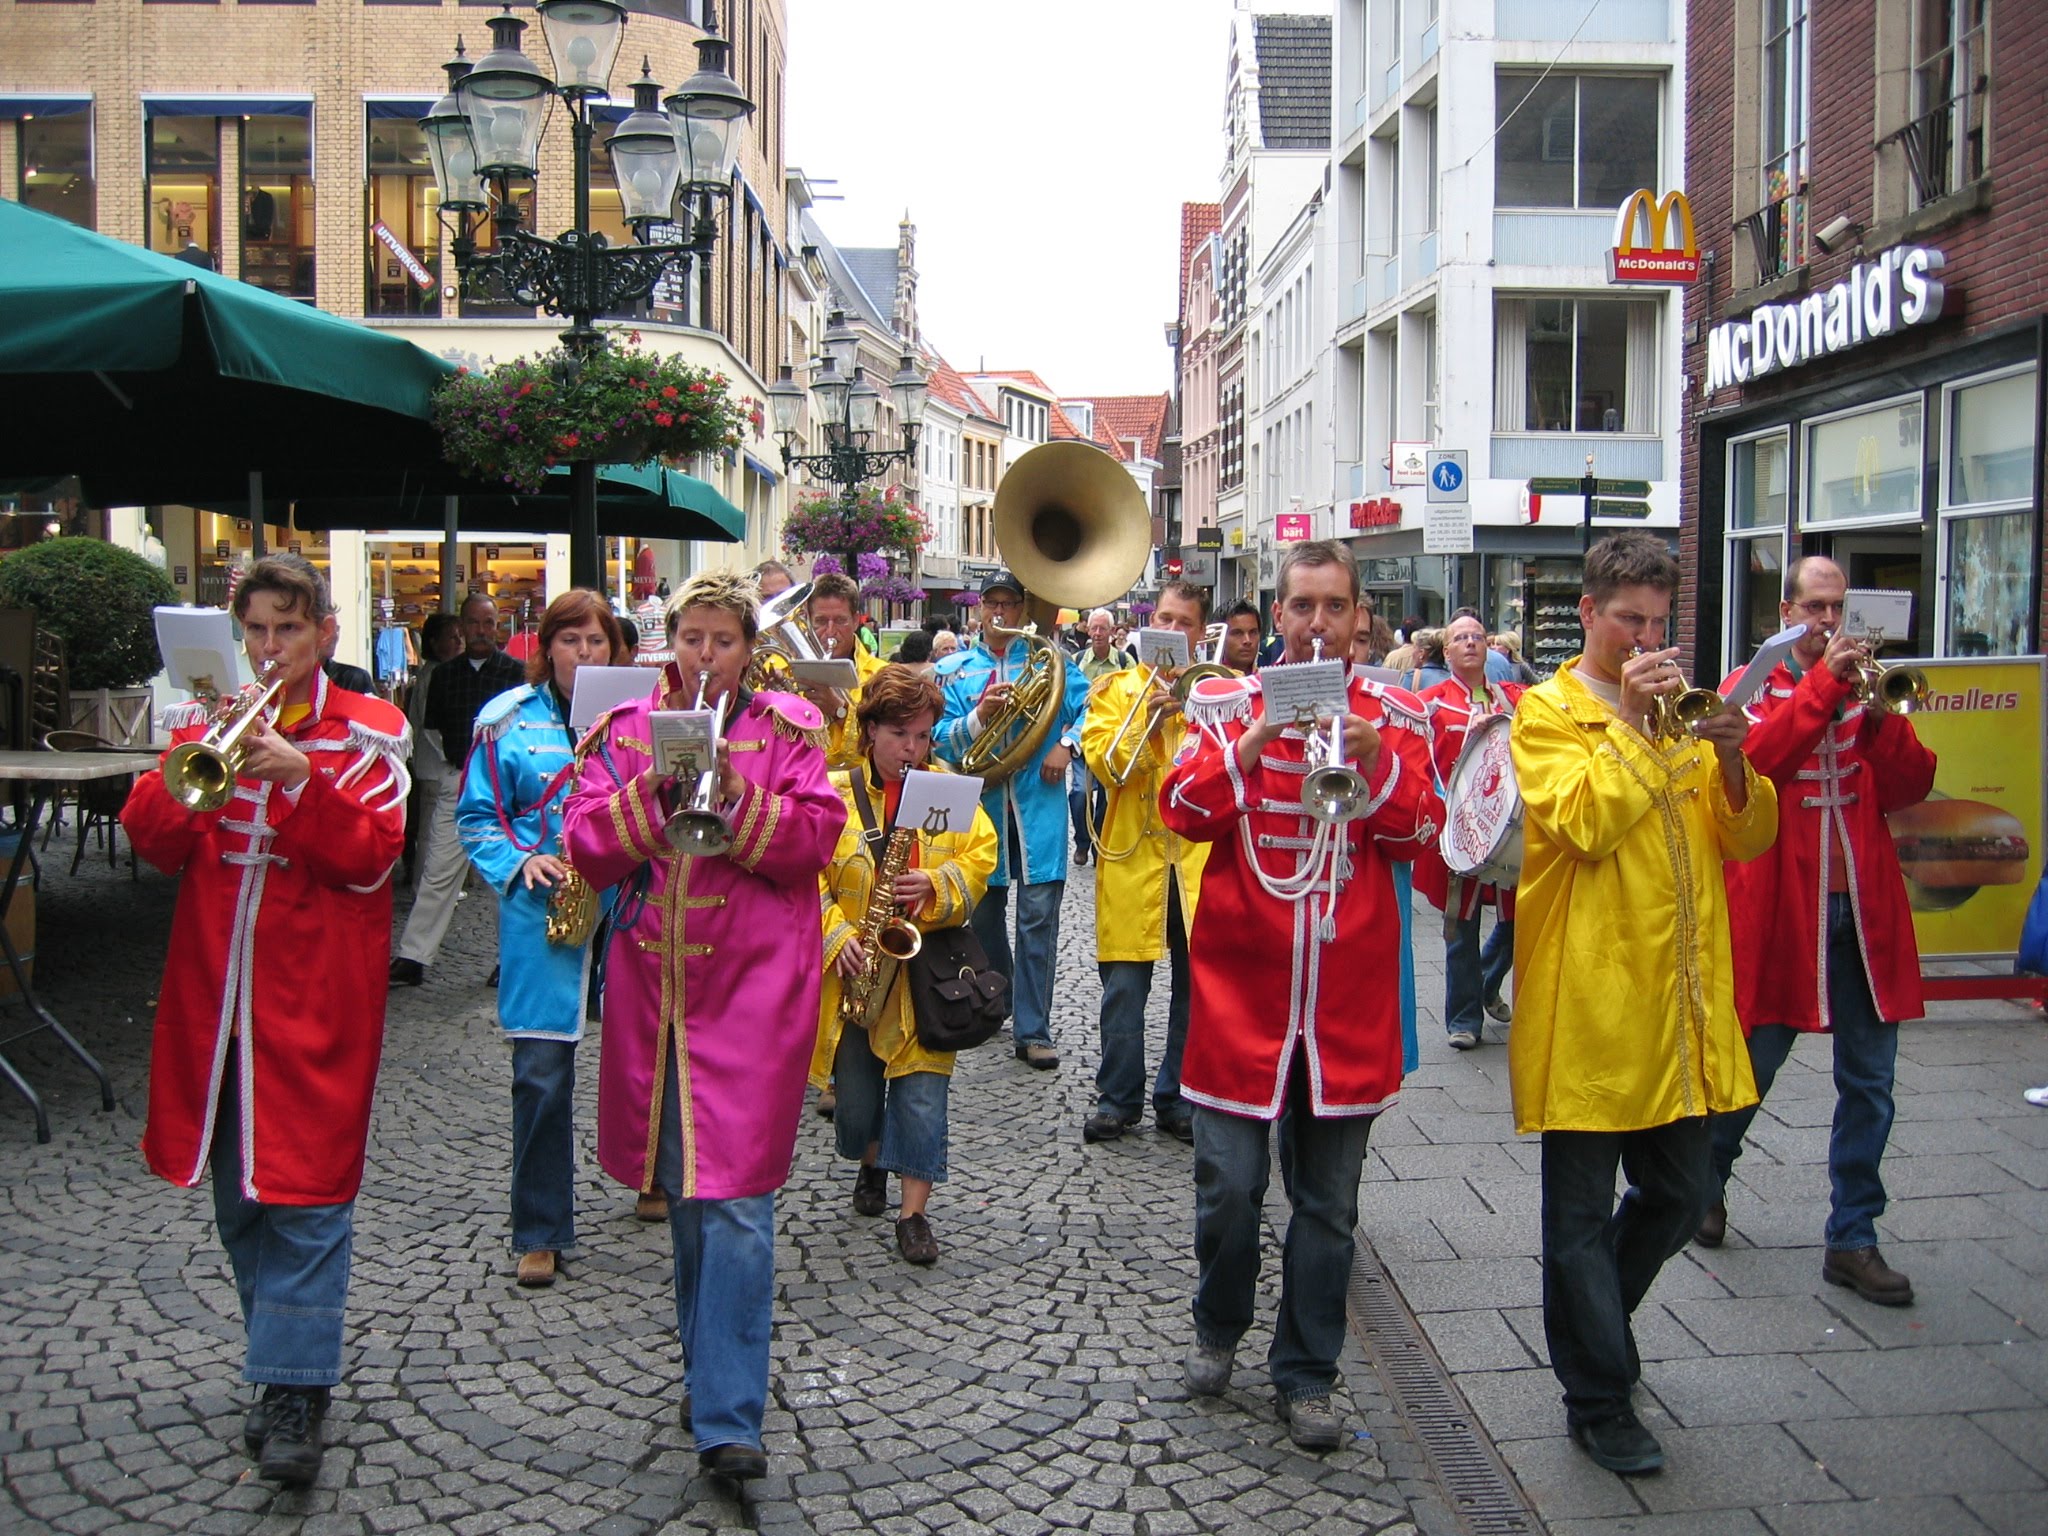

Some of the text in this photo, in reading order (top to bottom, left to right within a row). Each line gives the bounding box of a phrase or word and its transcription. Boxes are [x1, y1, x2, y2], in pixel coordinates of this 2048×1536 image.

[377, 226, 429, 283] UITVERKOOP
[1618, 258, 1696, 271] McDonald's
[1706, 245, 1936, 392] McDonald's
[1282, 527, 1304, 538] bart
[1198, 540, 1221, 548] sacha
[1919, 688, 2018, 712] Knallers
[1970, 785, 2006, 794] Hamburger
